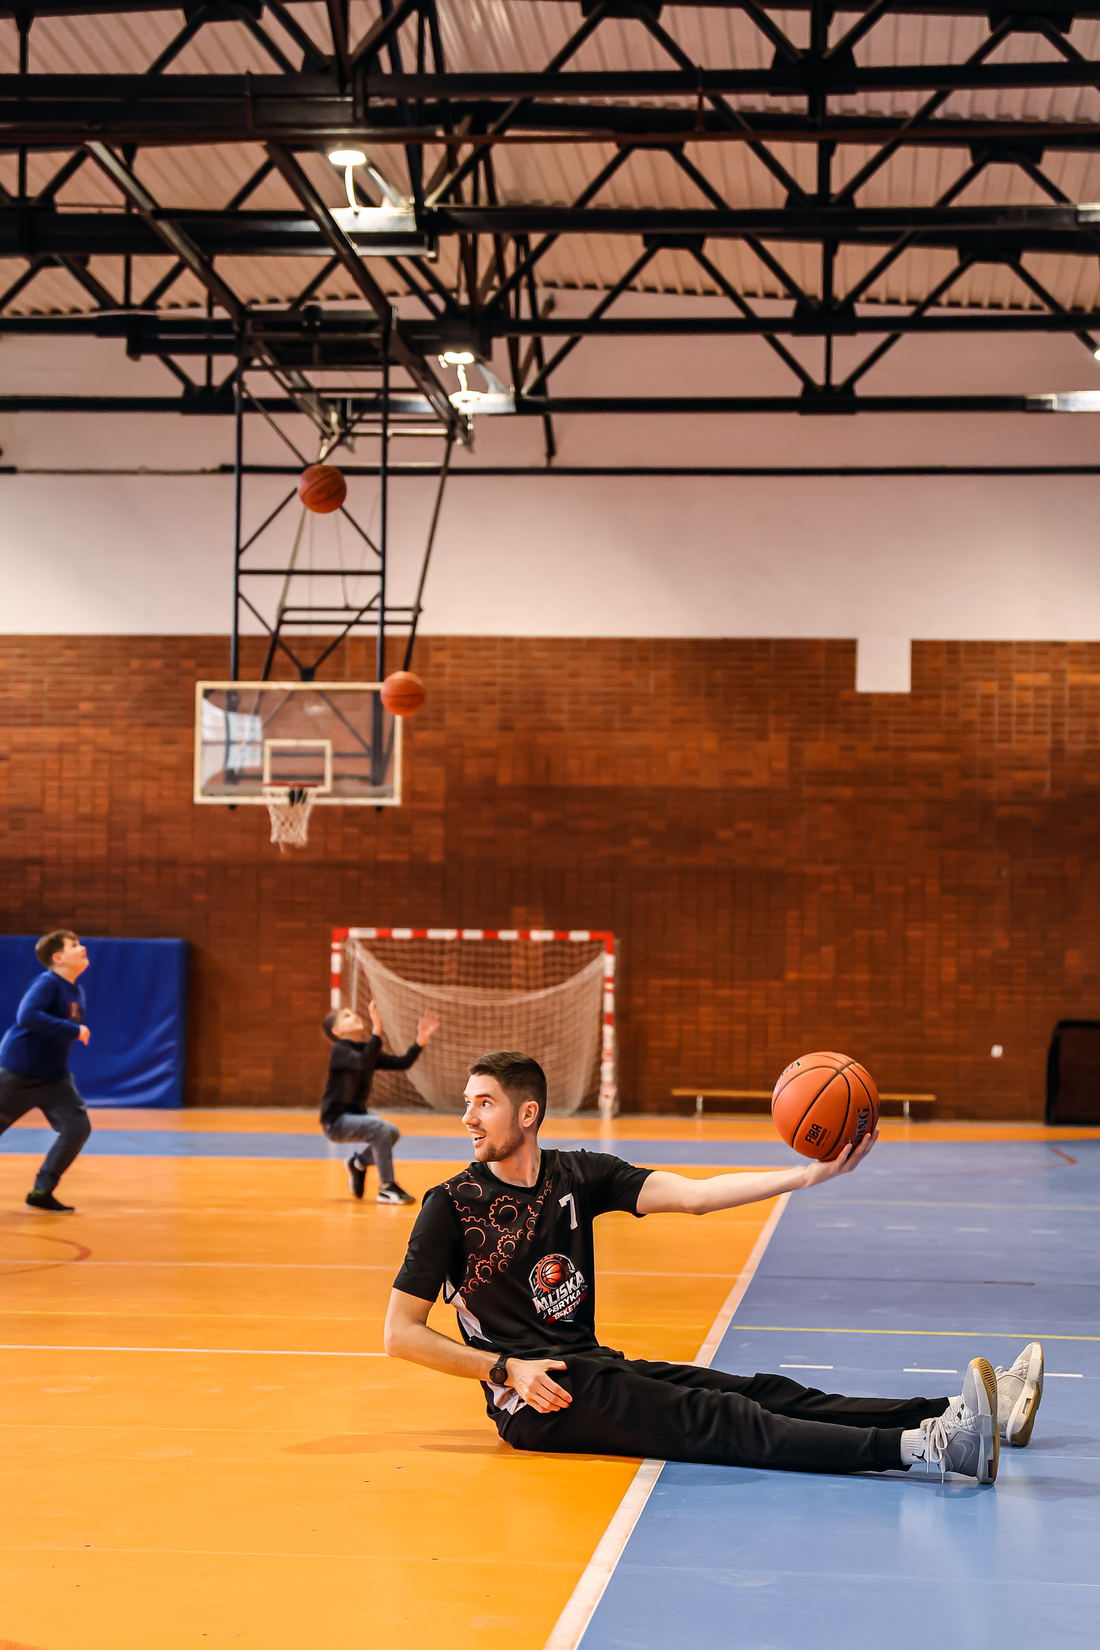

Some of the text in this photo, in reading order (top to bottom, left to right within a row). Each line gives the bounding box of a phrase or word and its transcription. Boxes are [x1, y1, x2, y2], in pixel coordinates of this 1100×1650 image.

[805, 1124, 823, 1145] FIBA
[558, 1192, 578, 1230] 7
[546, 1289, 582, 1316] FBRYKA
